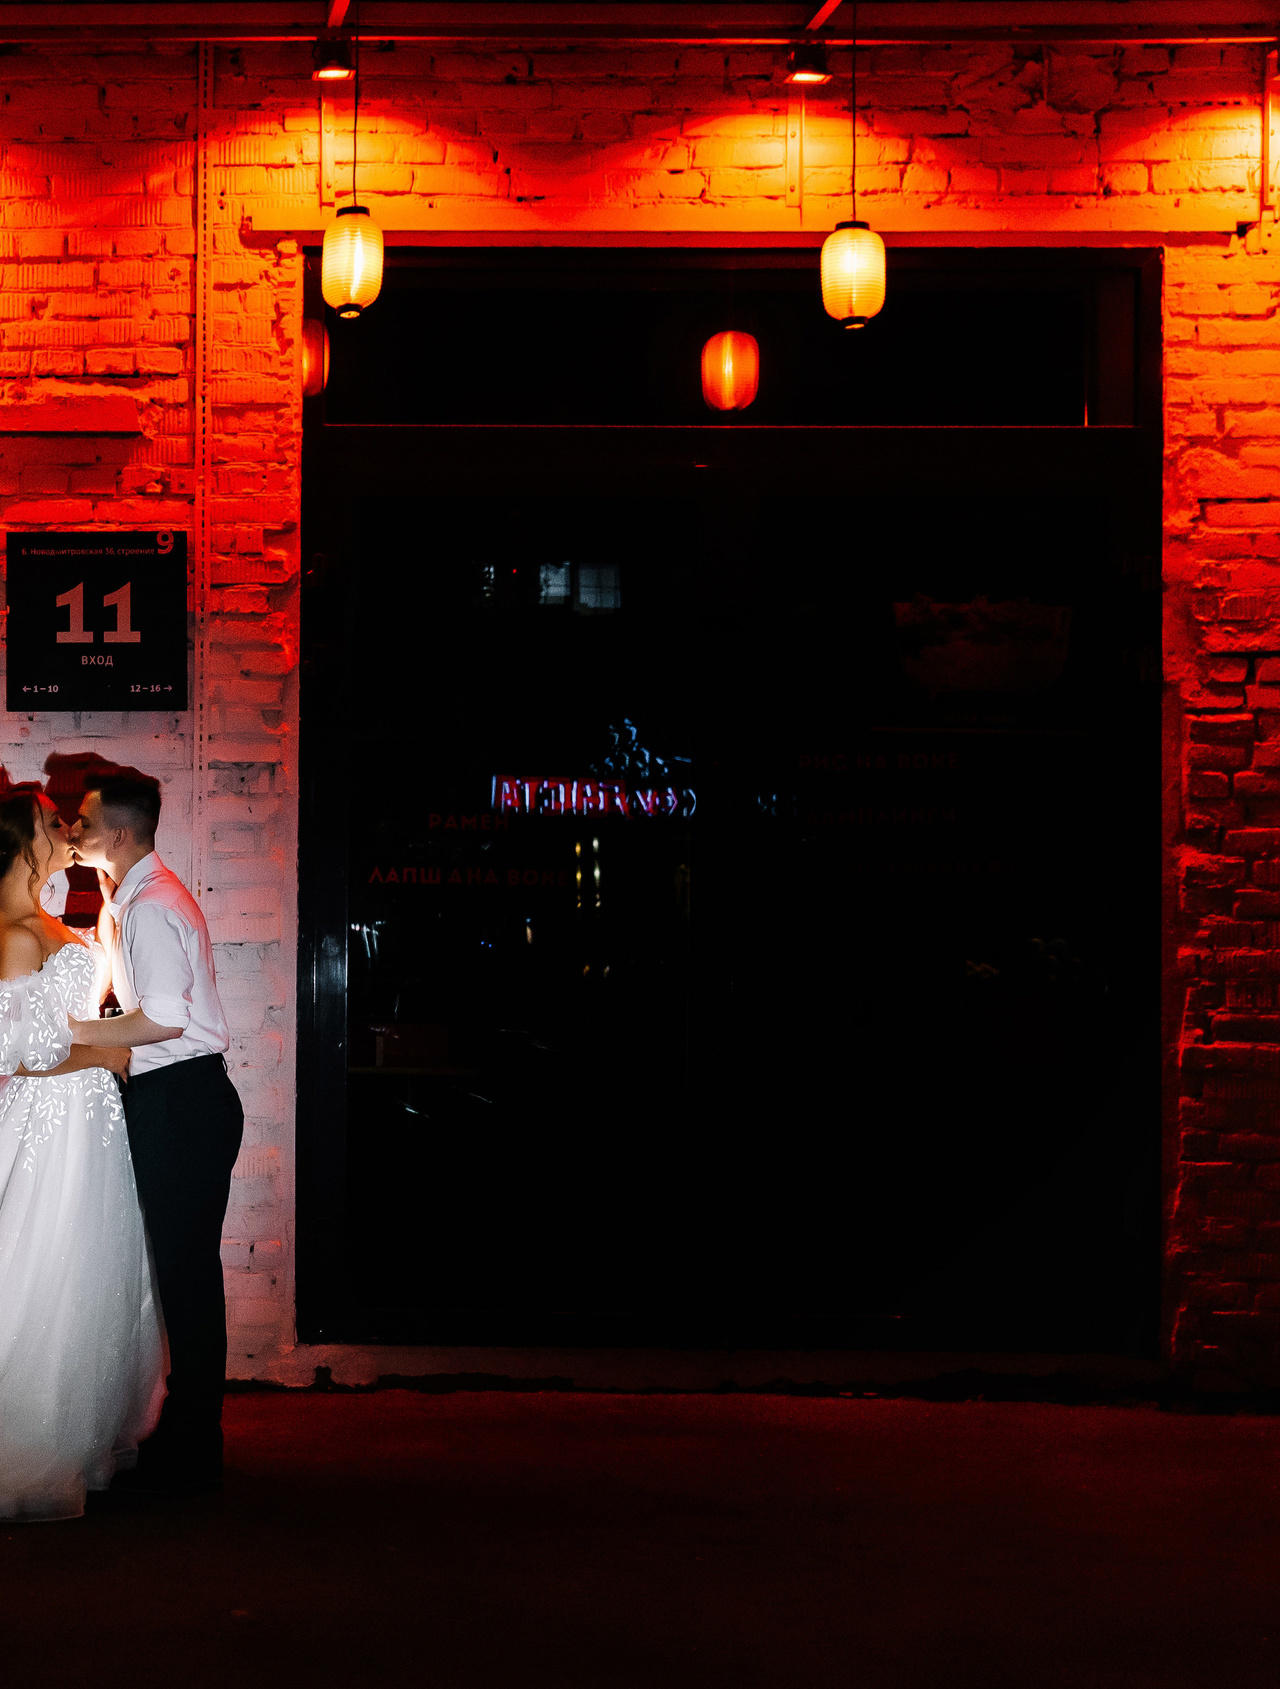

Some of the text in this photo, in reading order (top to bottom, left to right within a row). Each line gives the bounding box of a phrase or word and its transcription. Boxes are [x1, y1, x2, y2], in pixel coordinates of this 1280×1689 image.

[117, 548, 155, 558] строение
[156, 531, 175, 555] 9
[55, 580, 142, 644] 11
[81, 655, 114, 667] ВХОД
[428, 812, 510, 831] РАМЕН
[506, 868, 569, 888] ВОКЕ
